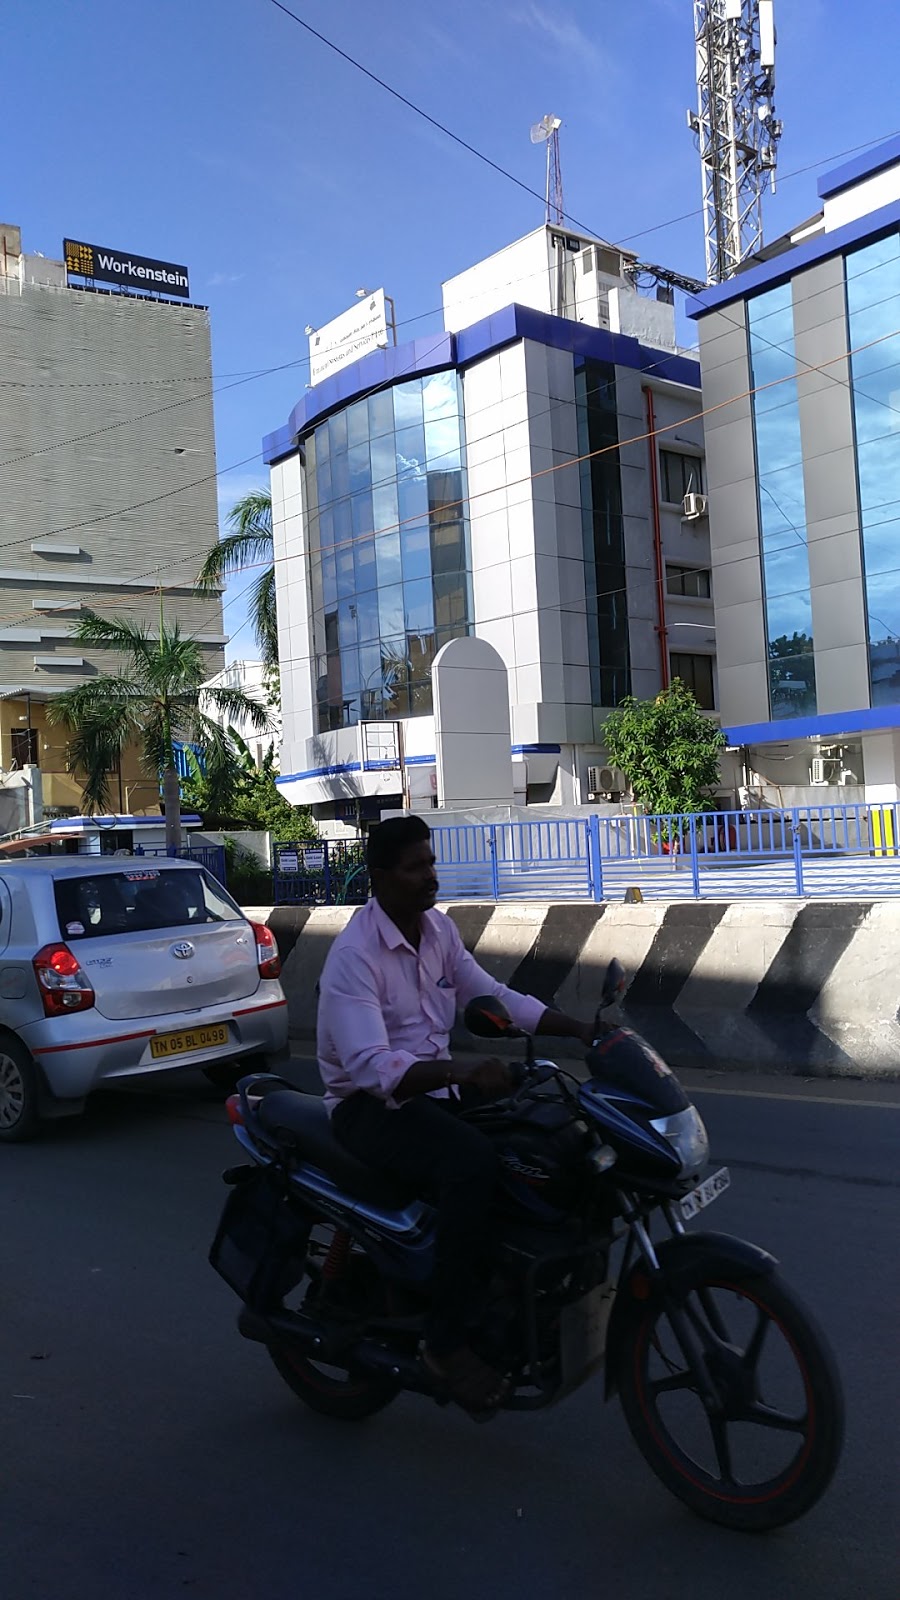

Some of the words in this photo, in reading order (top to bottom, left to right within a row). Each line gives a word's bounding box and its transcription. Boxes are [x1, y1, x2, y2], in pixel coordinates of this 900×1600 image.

[97, 253, 189, 288] Workenstein
[154, 1039, 168, 1053] TN
[170, 1037, 183, 1050] 05
[185, 1034, 198, 1048] BL
[200, 1028, 225, 1045] 0498
